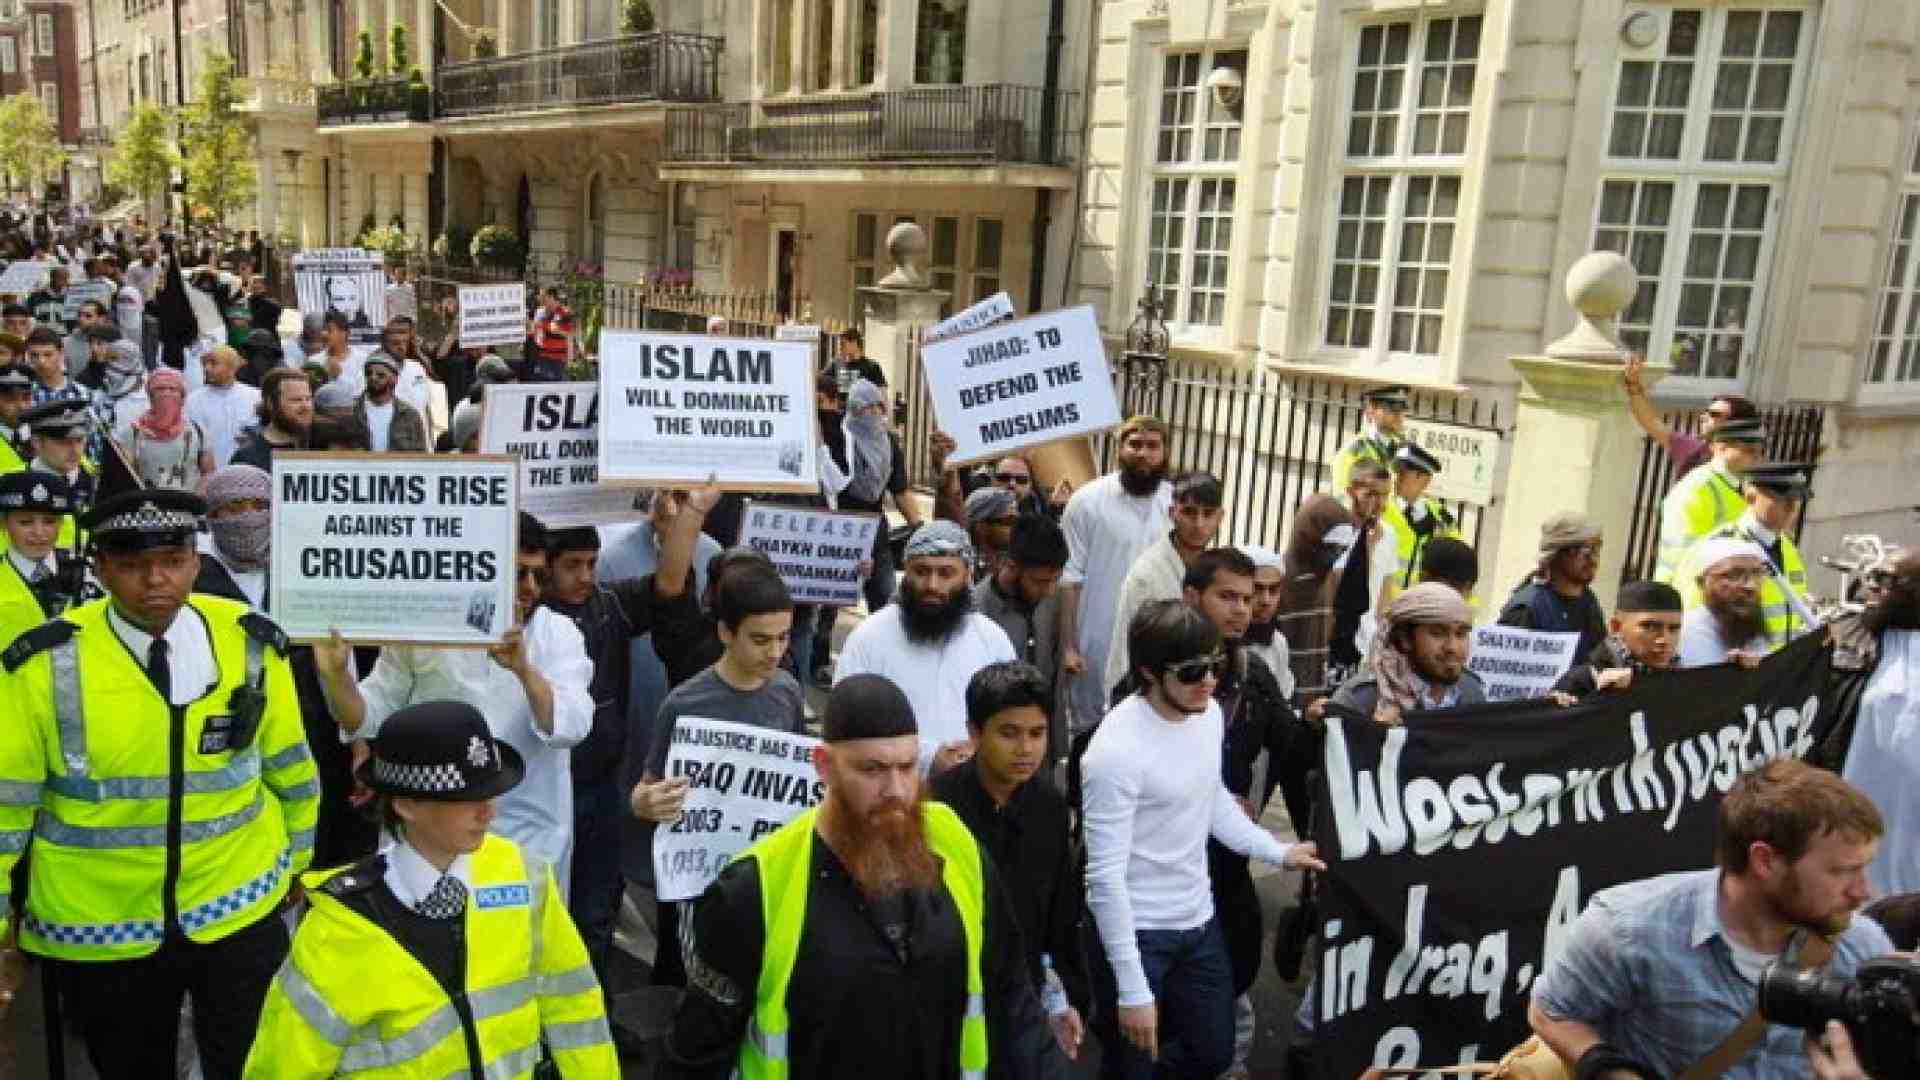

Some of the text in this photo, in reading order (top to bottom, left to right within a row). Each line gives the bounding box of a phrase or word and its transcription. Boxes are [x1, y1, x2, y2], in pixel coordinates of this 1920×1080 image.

[963, 327, 1062, 368] JIHAD: TO
[639, 344, 773, 384] ISLAM
[625, 387, 791, 413] WILL DOMINATE
[959, 361, 1083, 410] DEFEND THE
[654, 416, 775, 438] THE WORLD
[979, 403, 1081, 444] MUSLIMS
[506, 441, 551, 460] WILL
[282, 472, 427, 505] MUSLIMS
[437, 474, 508, 506] RISE
[529, 466, 564, 488] THE
[325, 514, 463, 538] AGAINST THE
[751, 511, 872, 539] RELEASE
[302, 547, 497, 582] CRUSADERS
[817, 544, 863, 560] OMAR
[671, 726, 758, 752] INJUSTICE
[759, 738, 792, 758] HAS
[672, 758, 736, 796] IRAQ
[670, 808, 724, 833] 2003
[1321, 917, 1374, 1022] in
